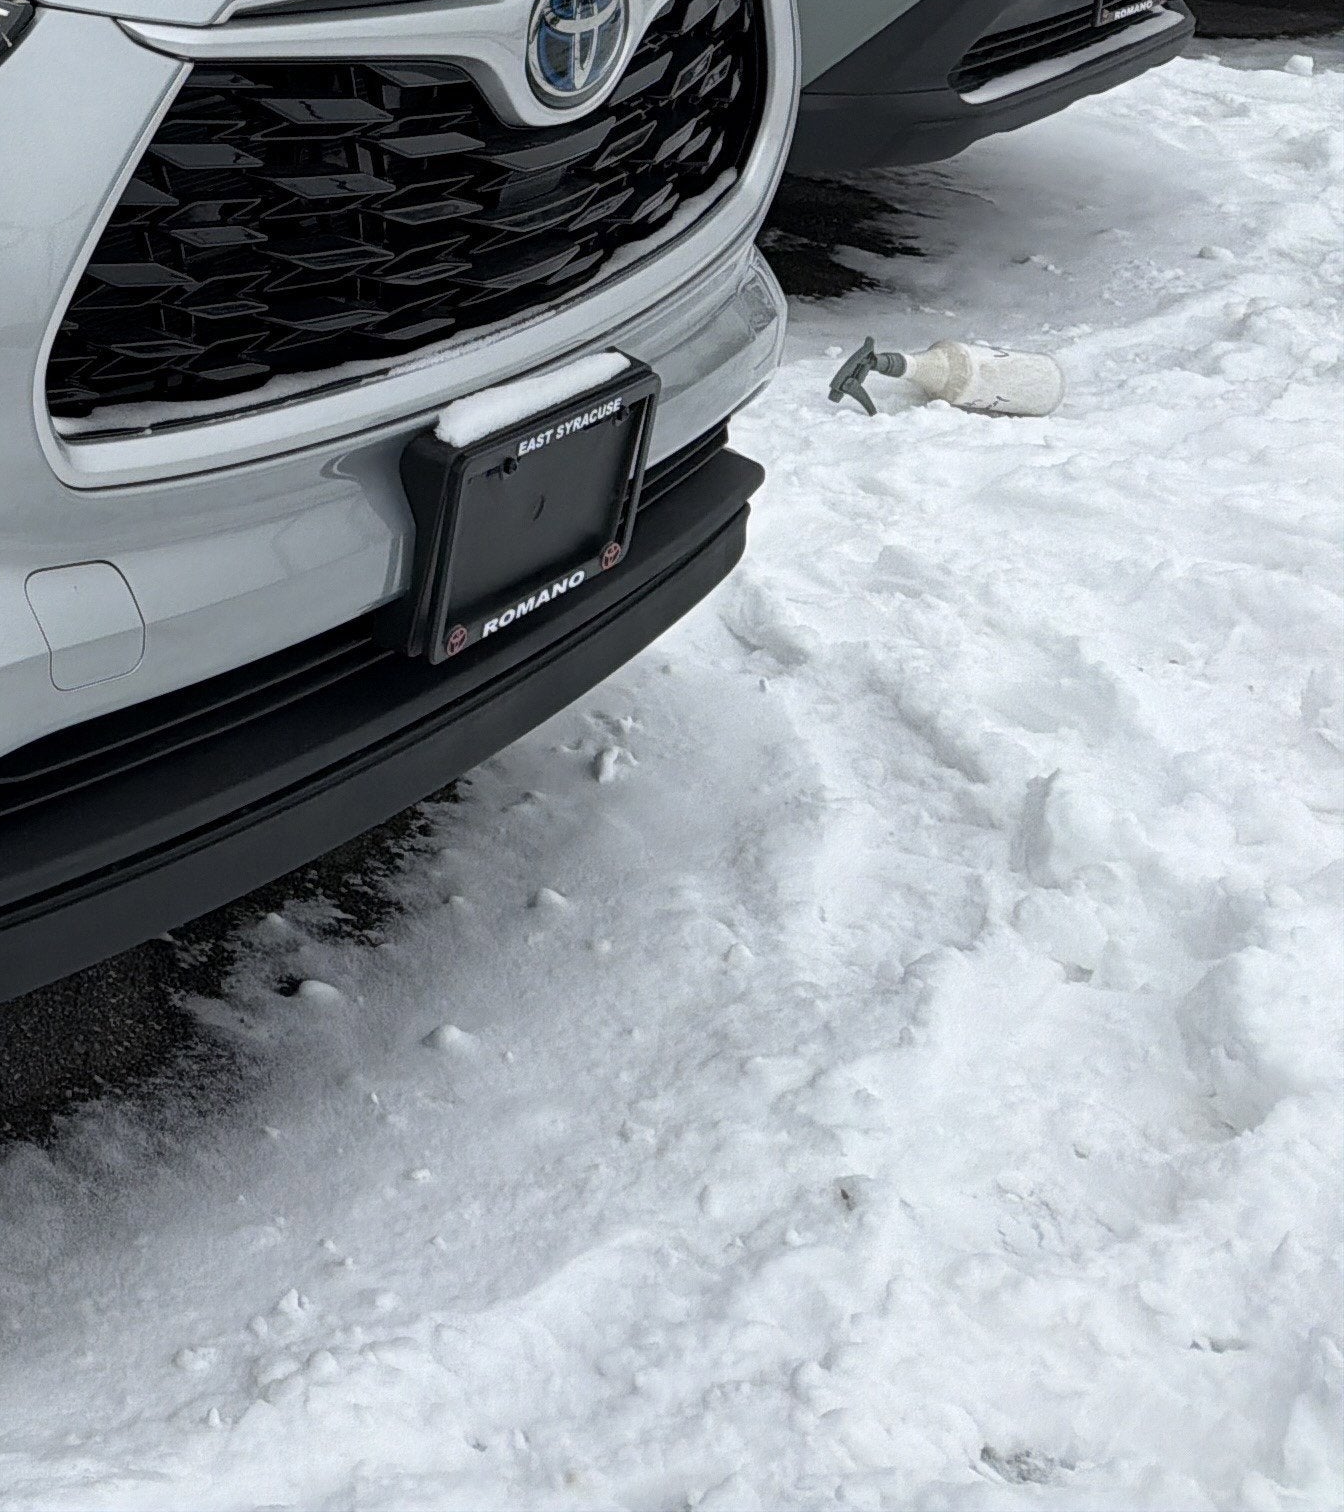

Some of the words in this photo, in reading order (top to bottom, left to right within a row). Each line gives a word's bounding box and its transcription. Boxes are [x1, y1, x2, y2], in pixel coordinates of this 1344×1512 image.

[1114, 0, 1154, 20] ROMANO
[517, 429, 554, 456] EAST
[555, 396, 623, 440] SYRACUSE
[482, 570, 586, 639] ROMANO
